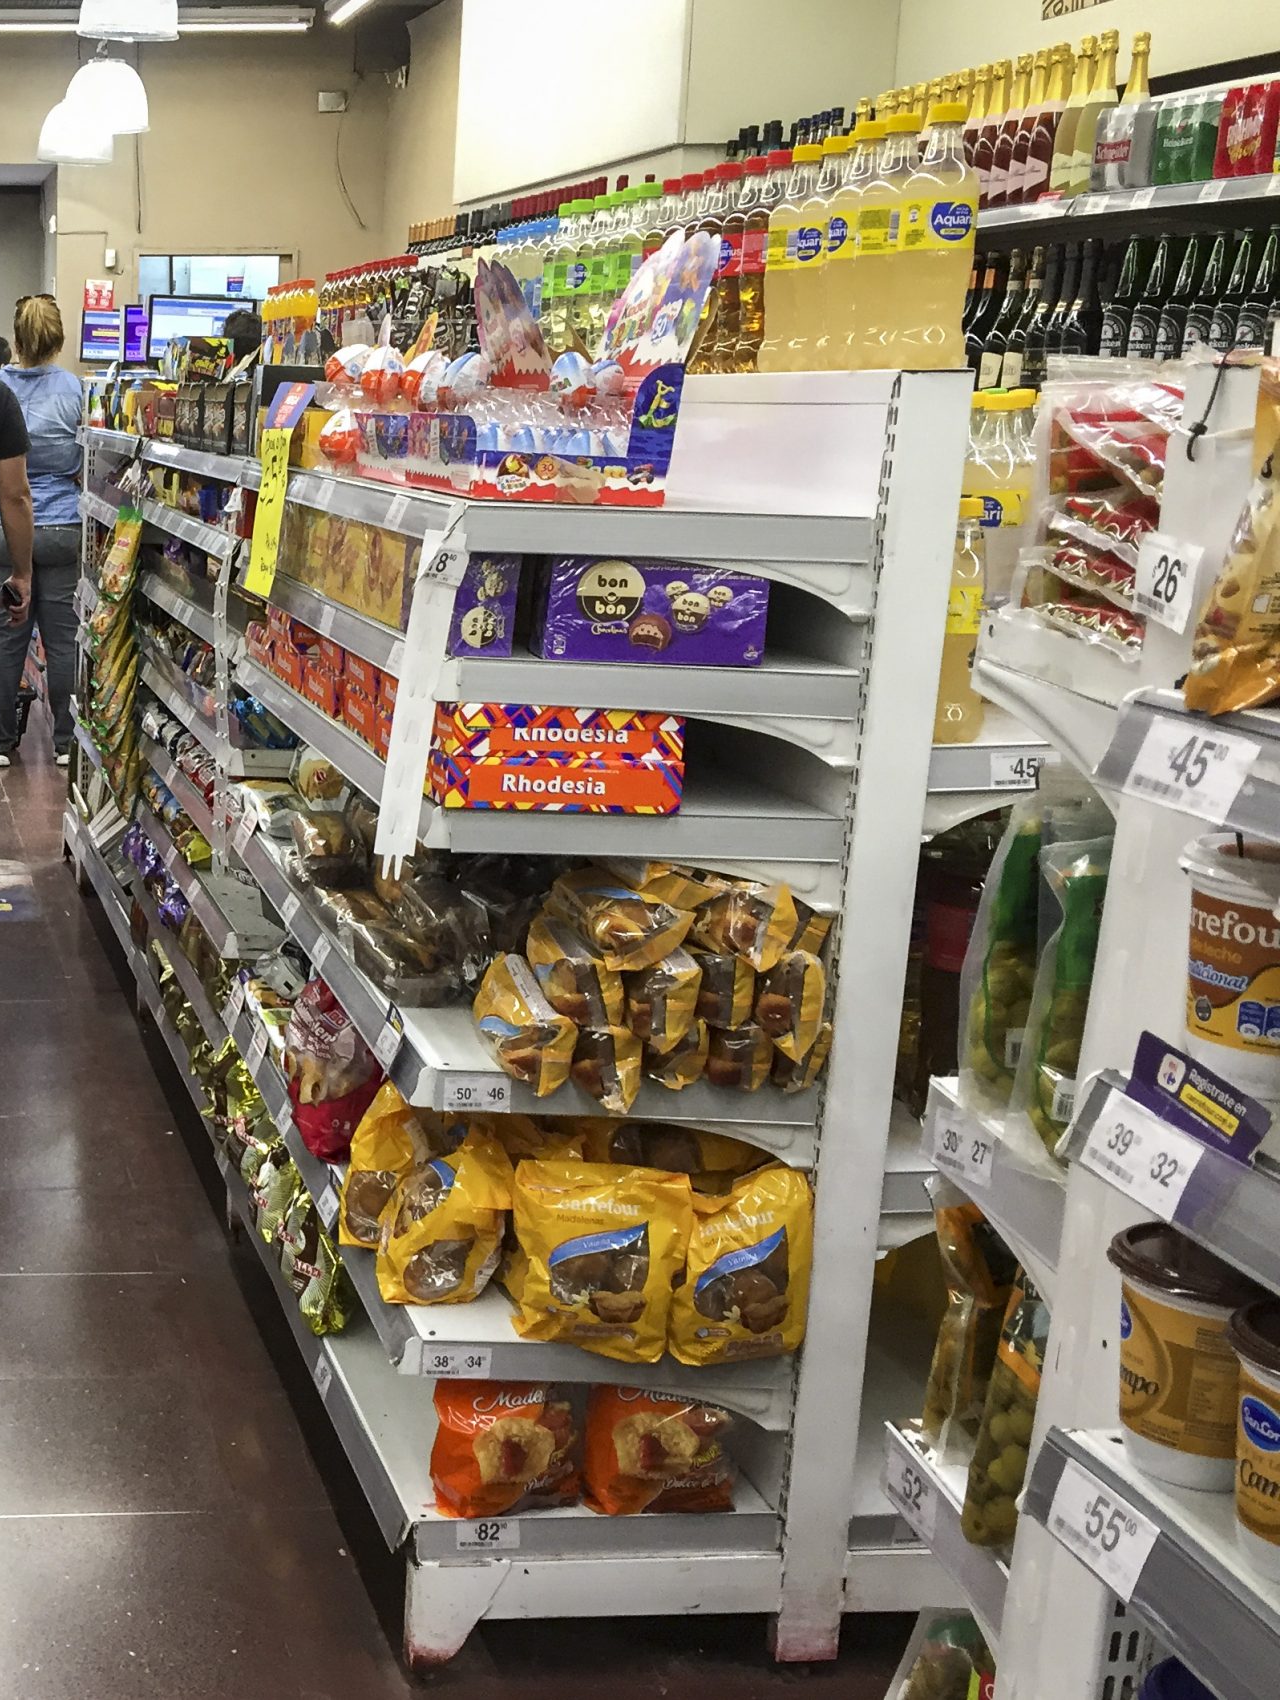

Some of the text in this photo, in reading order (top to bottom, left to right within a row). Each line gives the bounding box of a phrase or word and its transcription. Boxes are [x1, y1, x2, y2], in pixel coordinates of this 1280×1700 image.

[541, 463, 554, 472] 30
[597, 575, 628, 588] bon
[595, 602, 626, 614] bon
[682, 599, 700, 608] bon
[677, 612, 696, 623] bon
[502, 773, 606, 795] Rhodesia
[1189, 1068, 1247, 1117] Registrate en
[556, 1214, 604, 1225] Madalenas
[1243, 1405, 1280, 1442] SanCor
